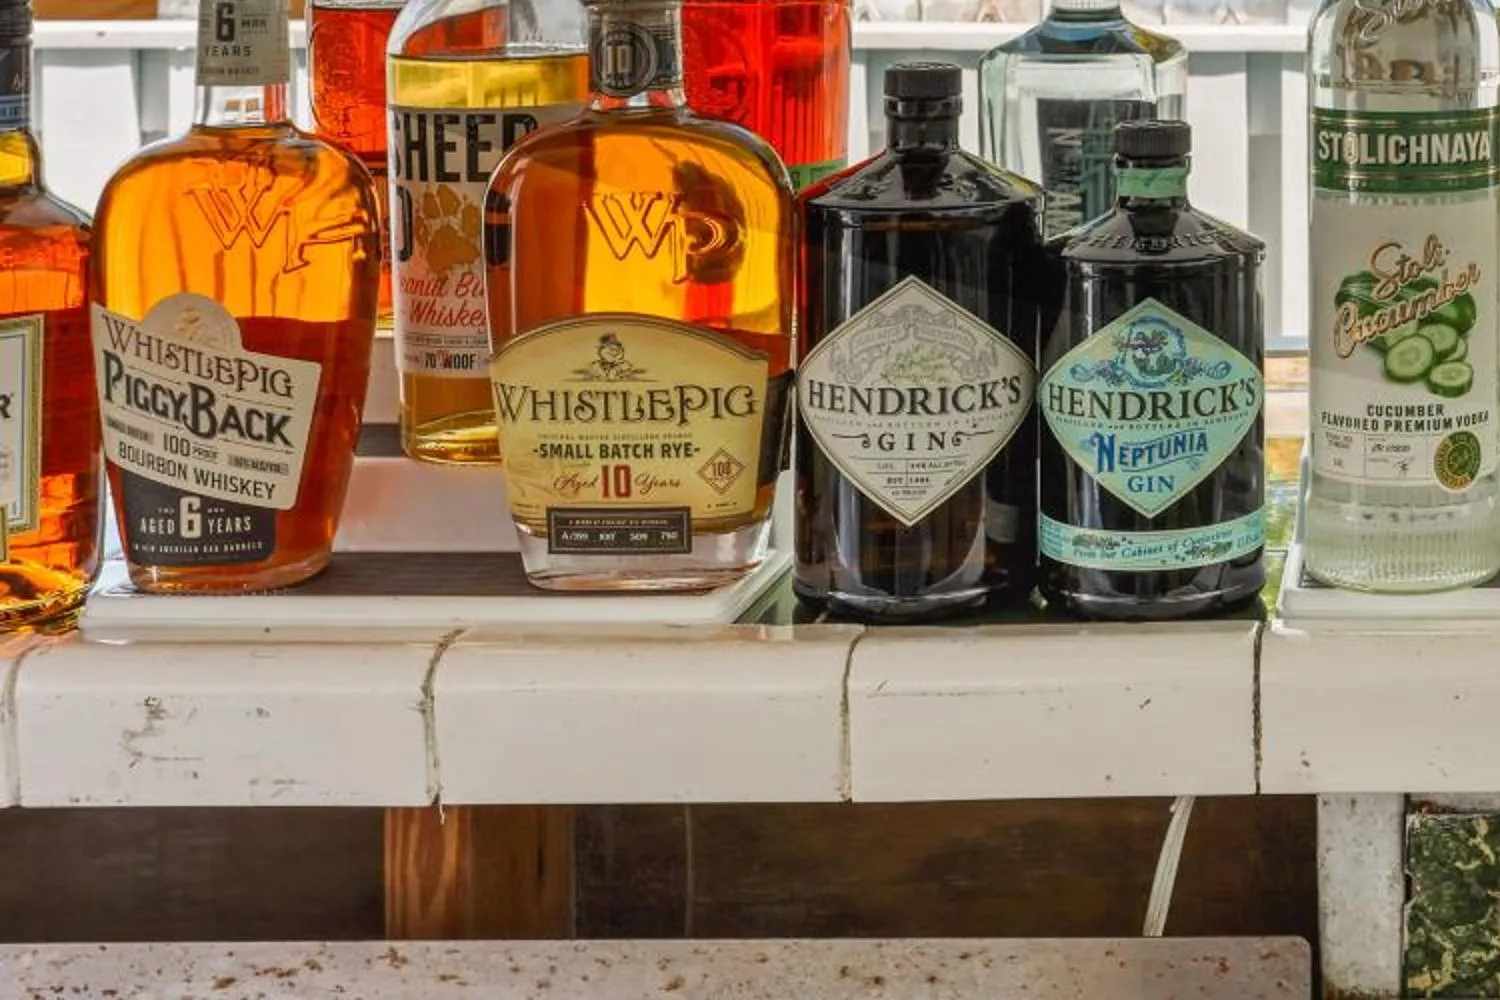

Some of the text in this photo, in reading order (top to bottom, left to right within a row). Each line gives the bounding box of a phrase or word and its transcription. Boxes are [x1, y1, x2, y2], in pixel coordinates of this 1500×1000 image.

[216, 2, 235, 42] 6
[204, 45, 251, 57] YEARS
[1318, 129, 1491, 166] STOLICHNAYA
[1370, 233, 1452, 301] Stoli
[1333, 262, 1482, 359] Cucumber
[101, 313, 295, 399] WHISTLEPIG
[494, 382, 760, 426] WHISTLEPIG
[808, 375, 1022, 417] HENDRICK'S
[1049, 377, 1258, 422] HENDRICK'S
[1367, 404, 1445, 417] CUCUMBER
[1321, 410, 1489, 433] FLAVORED PREMIUM VODKA
[163, 433, 191, 457] 100
[599, 443, 654, 459] BATCH
[877, 431, 947, 451] GIN
[1087, 430, 1209, 474] NEPTUNIA
[119, 440, 188, 481] BOURBON
[193, 467, 276, 500] WHISKEY
[553, 464, 683, 498] Aged 10 Years
[1127, 475, 1176, 494] GIN
[139, 515, 252, 535] AGED YEARS
[179, 496, 202, 539] 6
[1121, 544, 1164, 559] Cabinet
[1167, 538, 1178, 552] of
